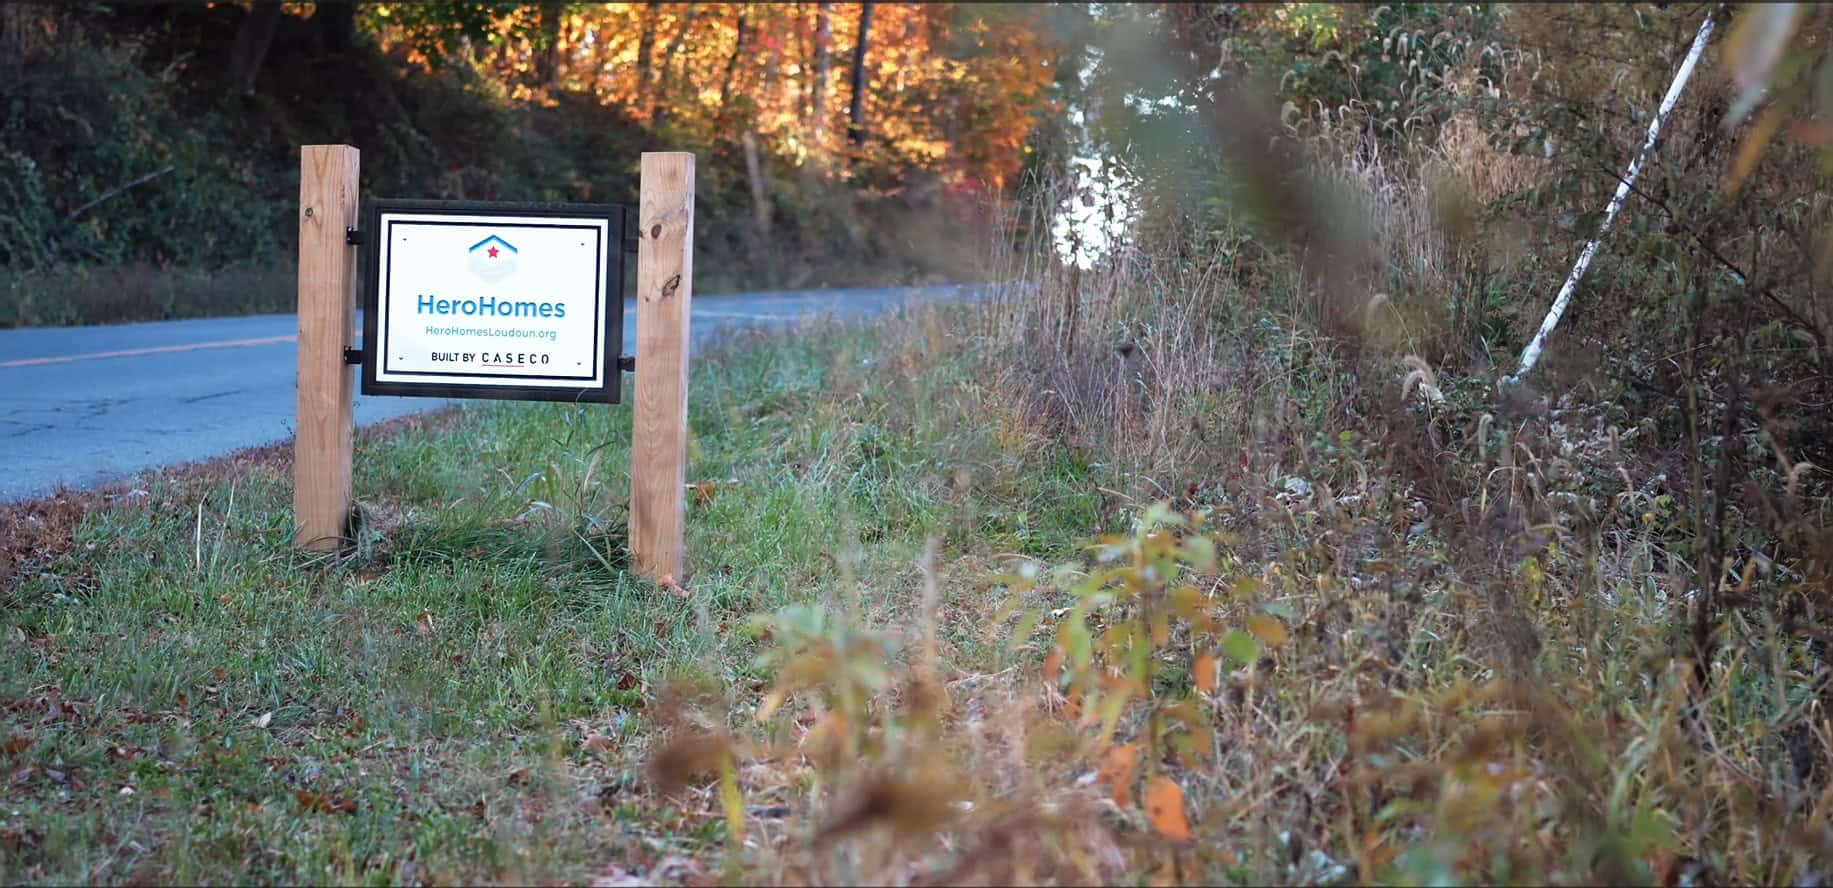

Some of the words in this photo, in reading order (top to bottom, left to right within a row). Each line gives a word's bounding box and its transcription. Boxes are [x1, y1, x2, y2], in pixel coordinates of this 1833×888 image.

[416, 294, 566, 318] HeroHomes
[425, 326, 557, 341] HeroHomesLoudoun.org
[431, 352, 459, 362] BUILT
[462, 352, 476, 362] BY
[481, 353, 549, 365] CASECO
